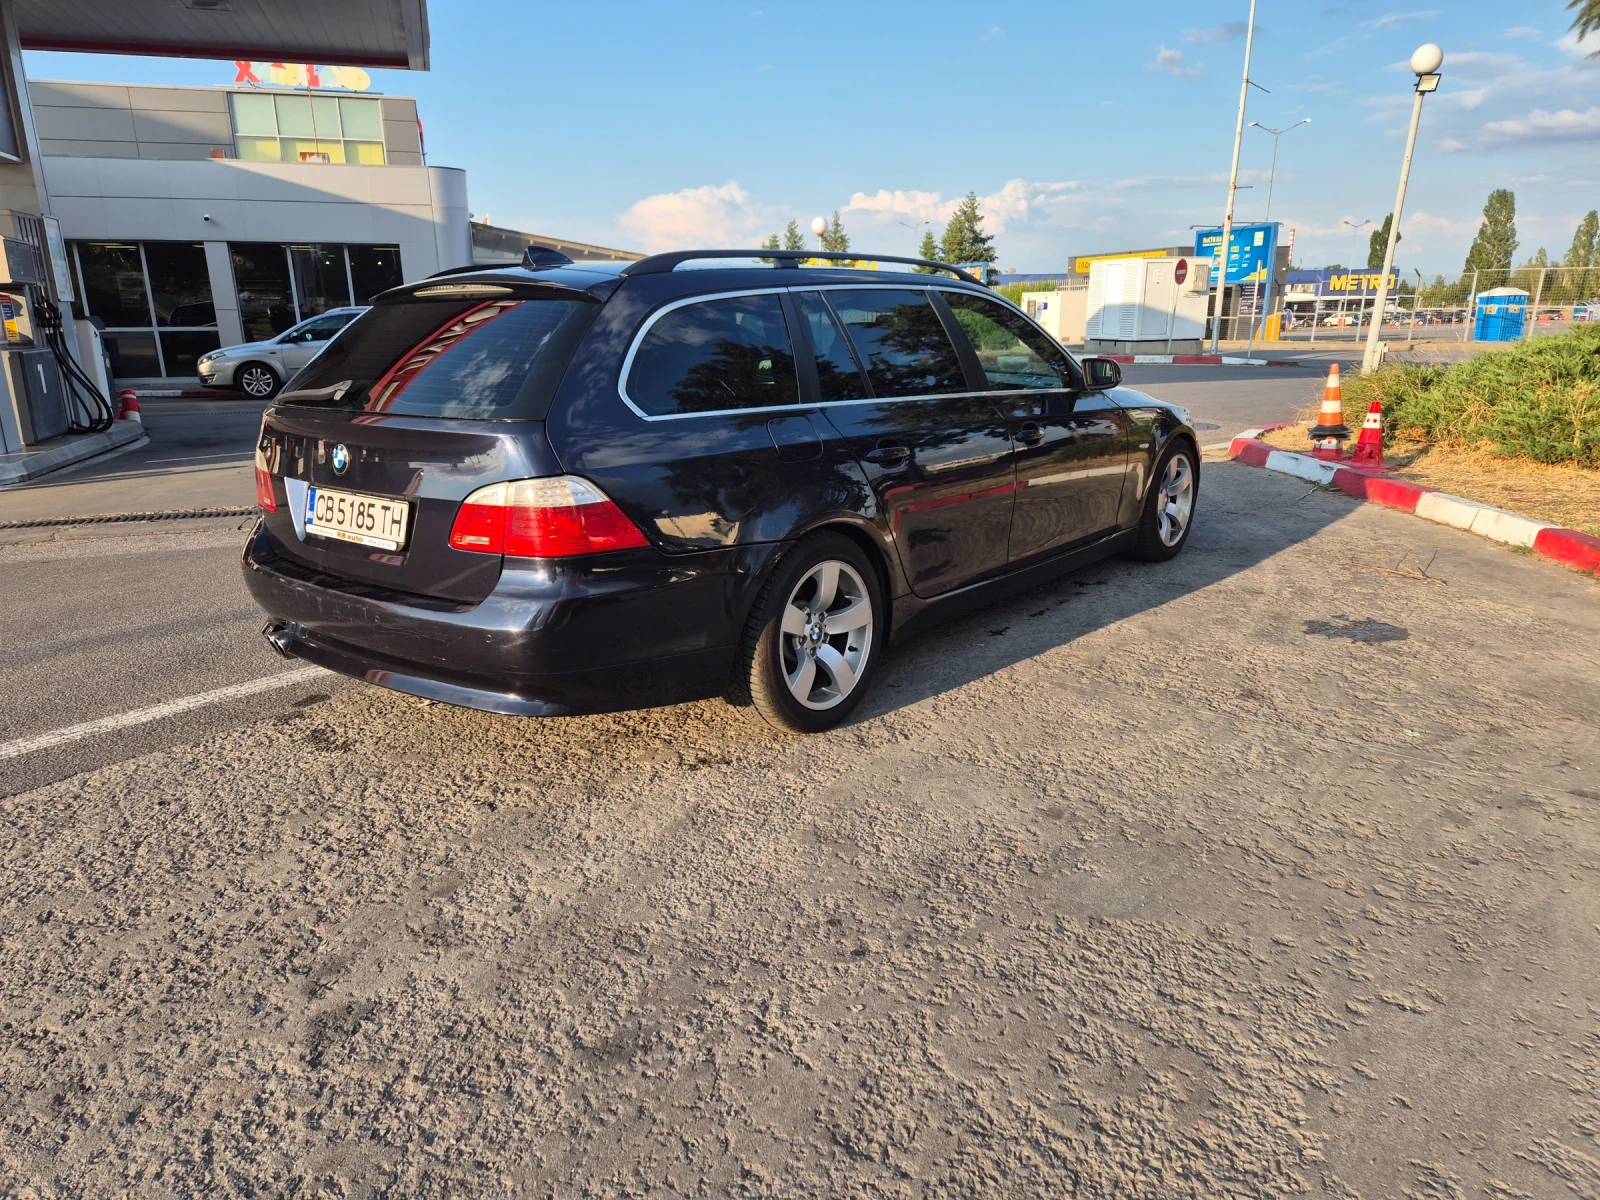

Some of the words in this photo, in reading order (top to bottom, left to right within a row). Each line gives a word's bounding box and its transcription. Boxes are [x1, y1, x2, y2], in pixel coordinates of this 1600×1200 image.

[37, 363, 47, 394] 1
[316, 495, 334, 522] CB
[337, 498, 376, 531] 5185
[381, 505, 403, 537] TH
[336, 531, 346, 539] RB
[347, 534, 363, 543] auto
